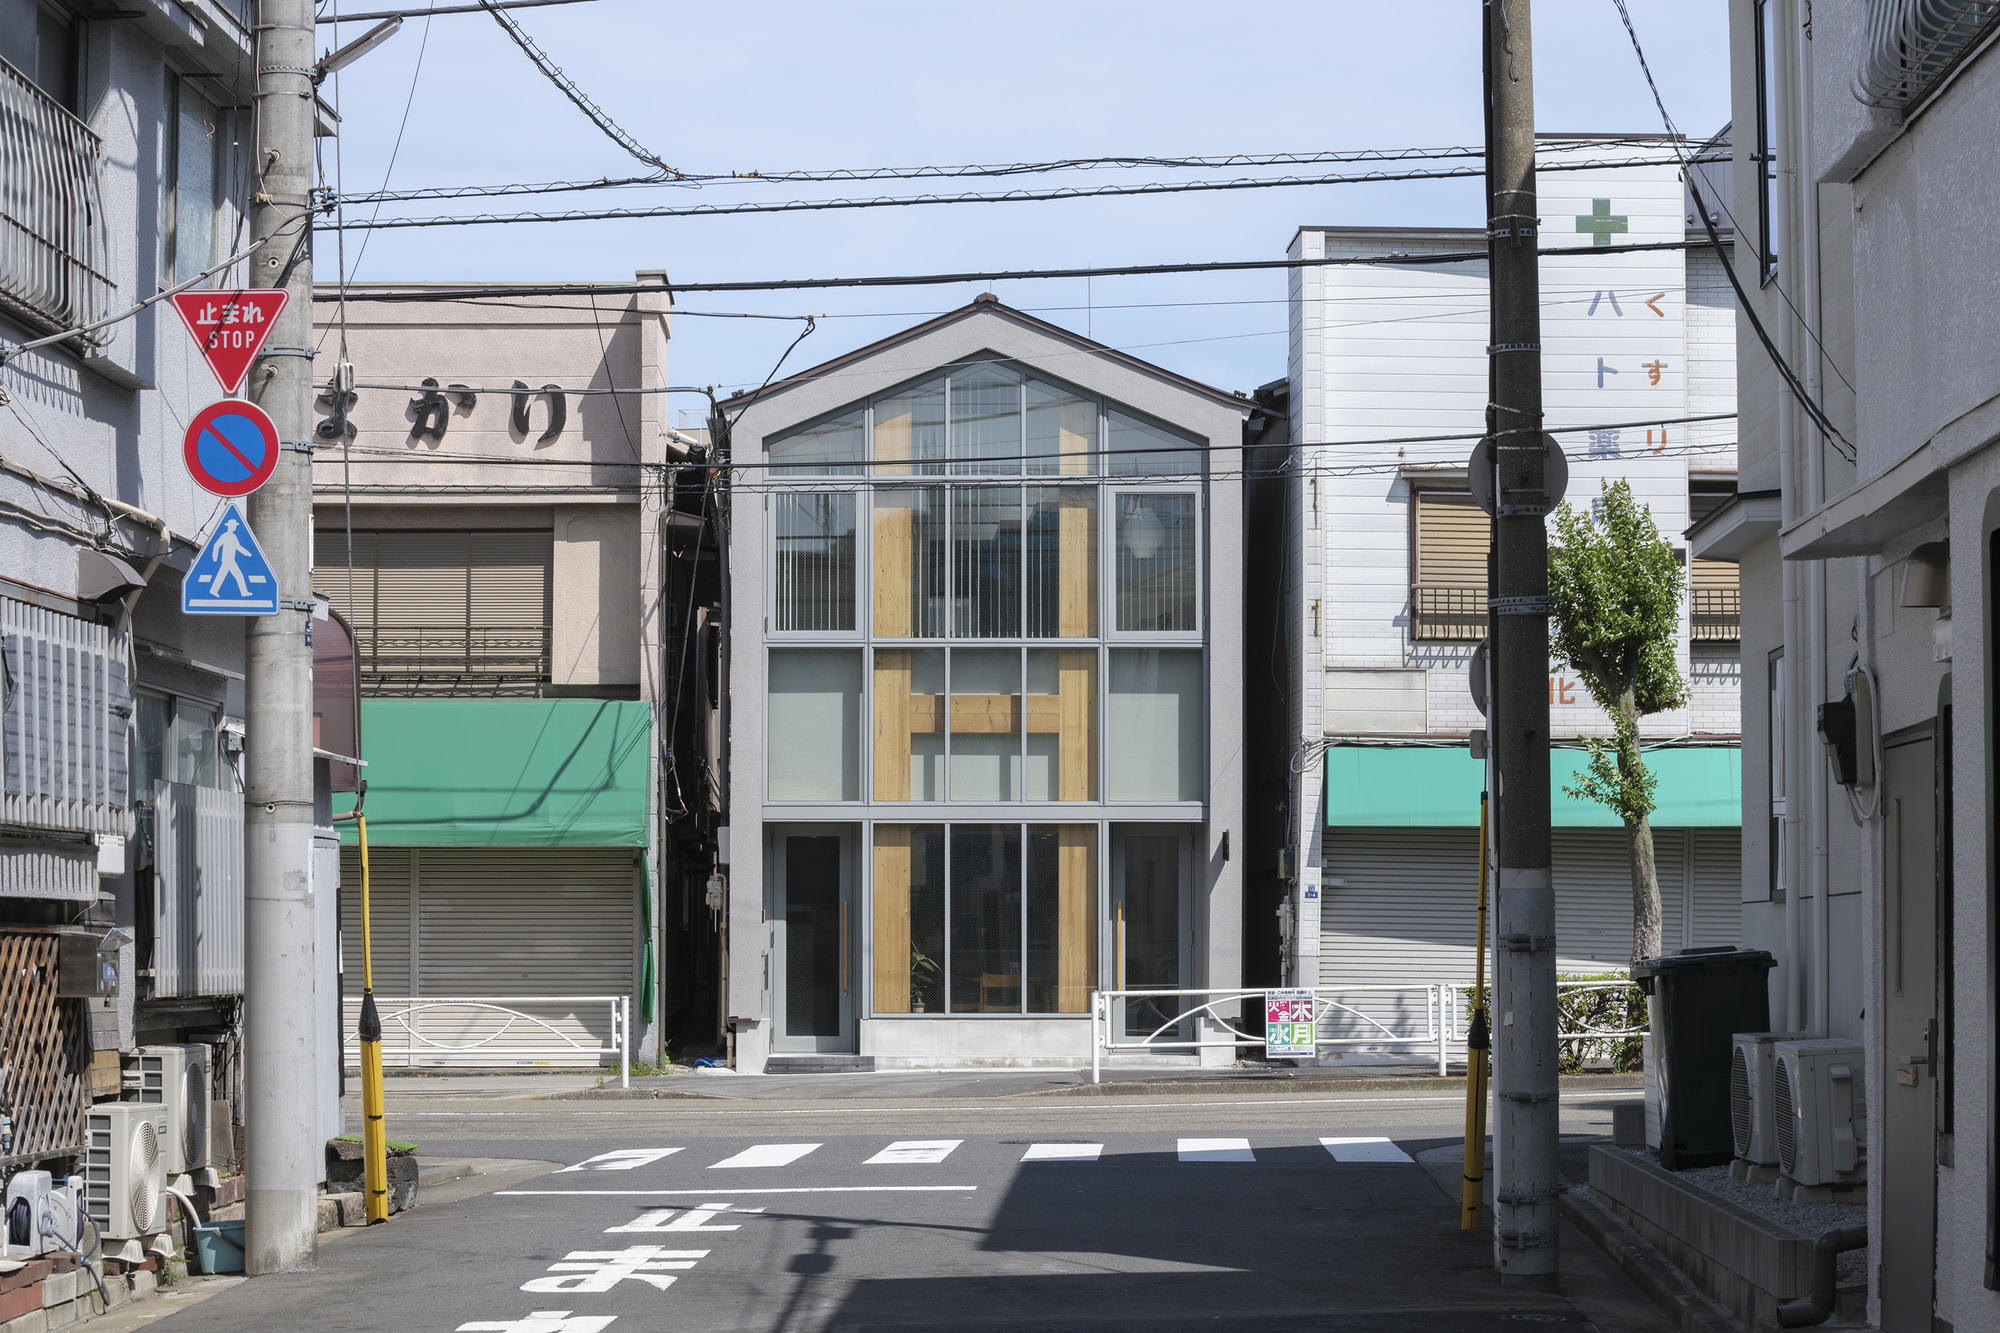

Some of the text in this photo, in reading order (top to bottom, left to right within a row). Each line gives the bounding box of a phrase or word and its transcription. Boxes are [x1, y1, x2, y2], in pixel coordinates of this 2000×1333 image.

[196, 301, 265, 326] 止まれ
[209, 330, 255, 349] STOP
[1642, 292, 1668, 455] くすり
[1278, 1010, 1290, 1022] 金
[1291, 1001, 1313, 1021] 木
[1269, 1023, 1290, 1045] 水
[1292, 1024, 1311, 1045] 月
